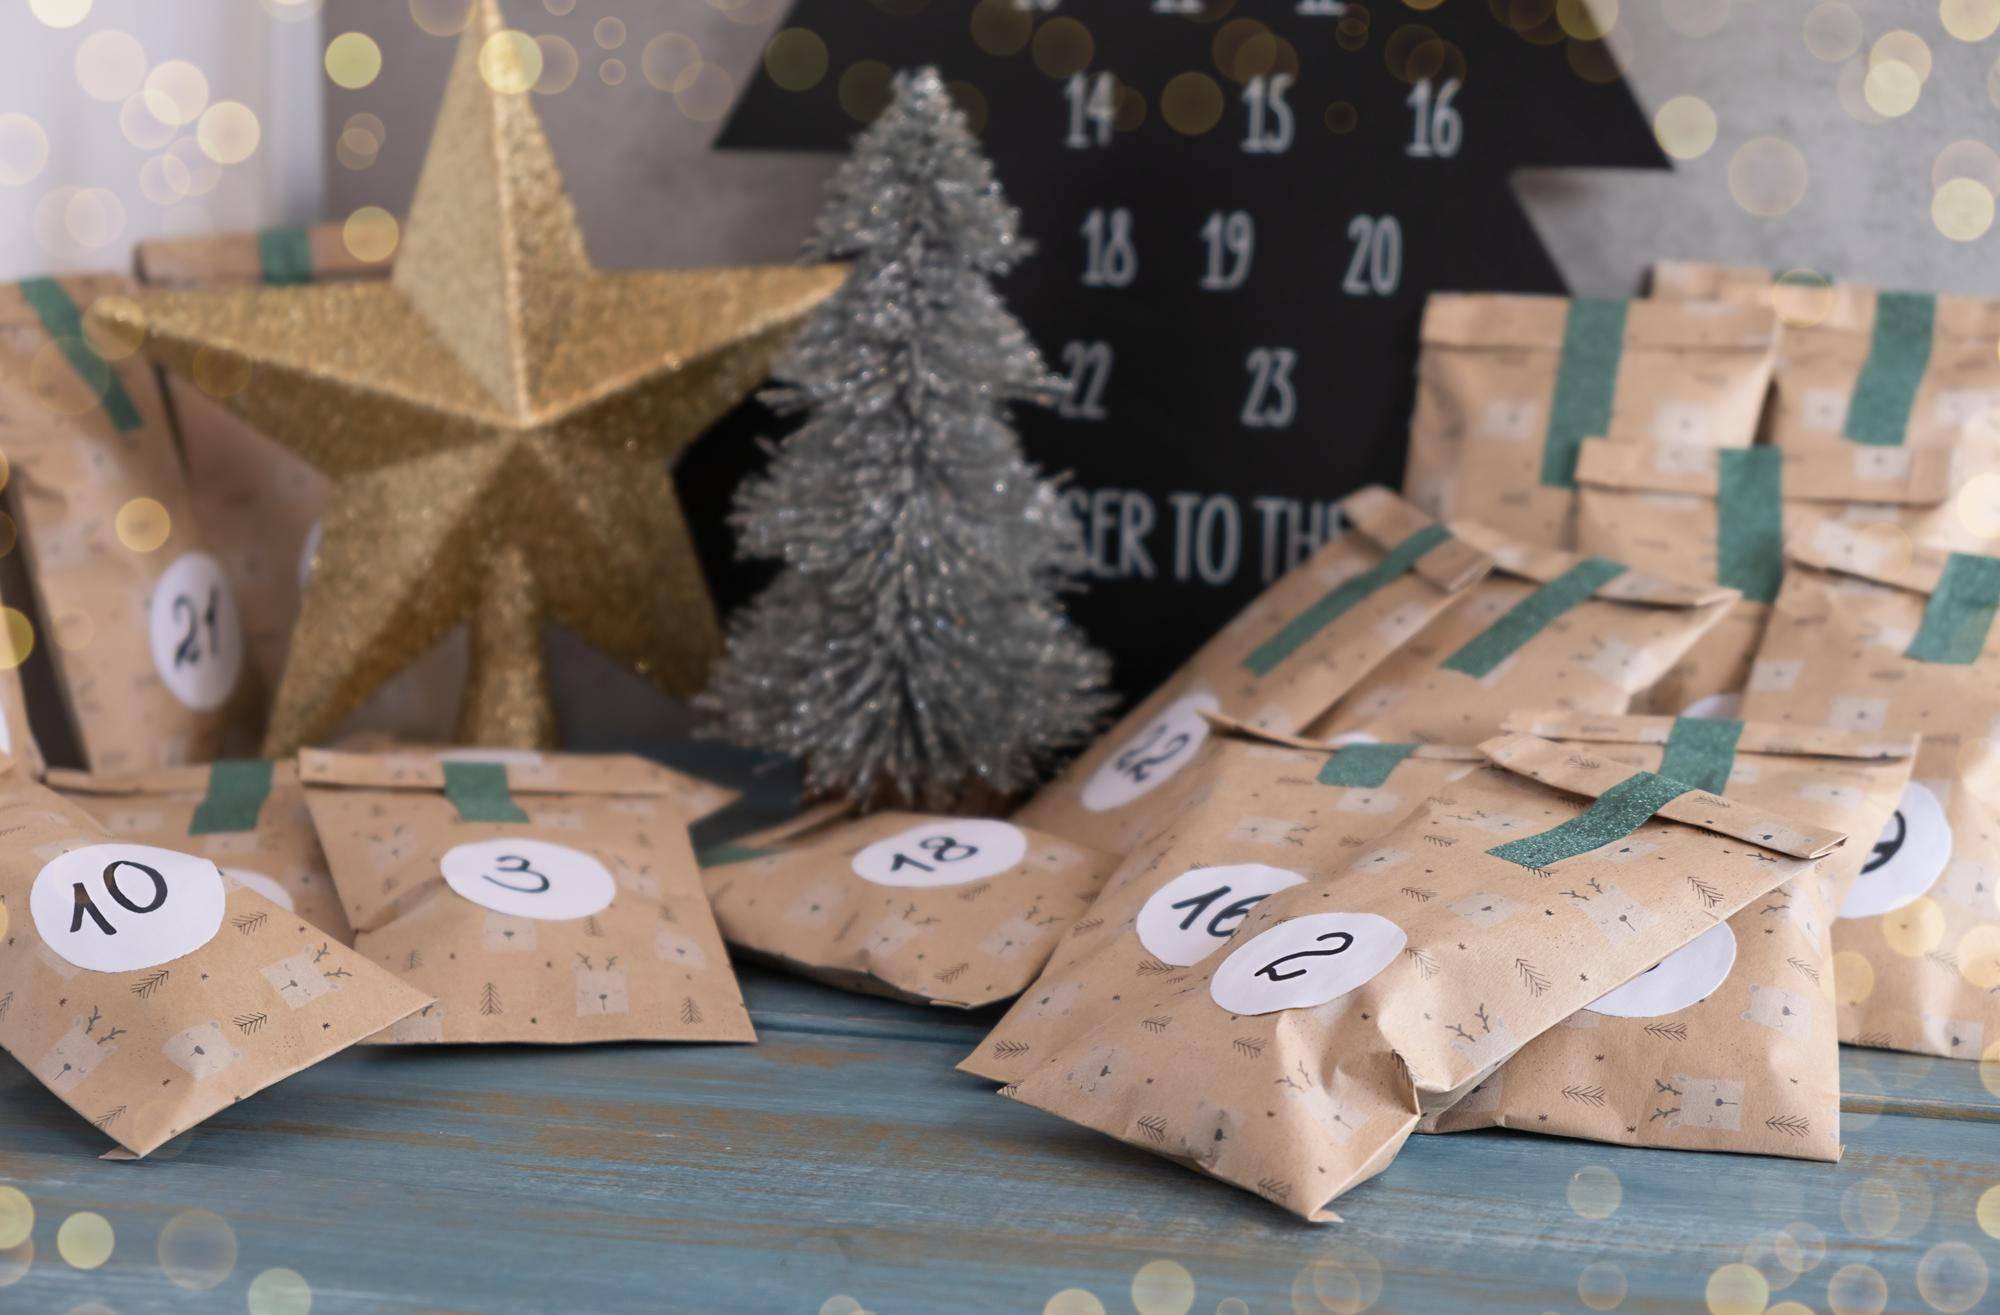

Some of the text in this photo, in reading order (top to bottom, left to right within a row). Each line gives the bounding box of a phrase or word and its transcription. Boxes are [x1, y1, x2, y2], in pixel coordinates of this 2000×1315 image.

[1065, 71, 1115, 149] 14
[1240, 73, 1295, 153] 15
[1406, 78, 1462, 157] 16
[1080, 207, 1138, 287] 18
[1200, 210, 1255, 290] 19
[1342, 215, 1401, 295] 20
[1060, 340, 1113, 420] 22
[1241, 347, 1298, 428] 23
[1168, 491, 1243, 585] TO
[173, 587, 220, 671] 21
[481, 854, 550, 894] 3
[889, 836, 979, 875] 18
[69, 860, 168, 936] 10
[1254, 931, 1354, 982] 2
